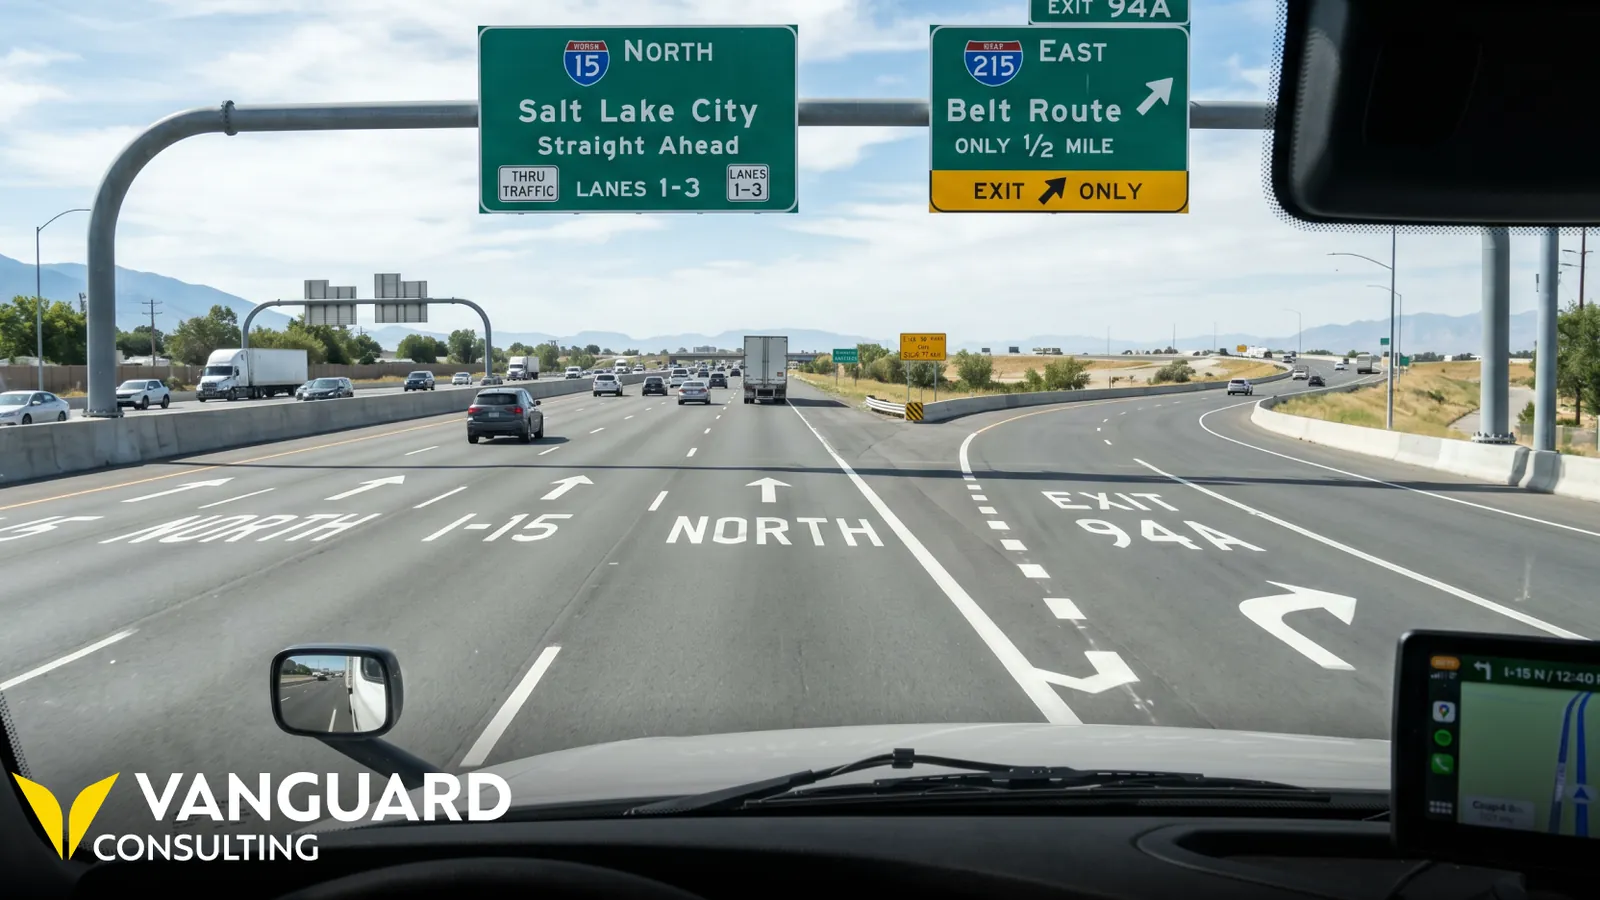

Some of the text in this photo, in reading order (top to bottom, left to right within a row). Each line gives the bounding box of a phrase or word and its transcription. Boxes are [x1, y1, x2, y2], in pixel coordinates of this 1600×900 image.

[1048, 0, 1171, 18] EXIT 94A
[624, 40, 713, 62] NORTH
[1039, 40, 1107, 62] EAST
[575, 55, 600, 77] 15
[973, 55, 1015, 77] 215
[518, 99, 758, 128] Salt Lake City
[947, 98, 1122, 122] Belt Route
[537, 136, 739, 161] Straight Ahead
[955, 138, 1011, 154] ONLY
[1066, 138, 1114, 154] MILE
[511, 170, 546, 183] THRU
[729, 169, 767, 180] LANES
[502, 185, 555, 198] TRAFFIC
[576, 177, 700, 197] LANES 1-3
[734, 182, 763, 197] 1-3
[974, 183, 1143, 200] EXIT ONLY
[1041, 491, 1179, 512] EXIT
[98, 512, 383, 544] NORTH
[421, 513, 574, 542] I-15
[665, 515, 885, 547] NORTH
[1075, 518, 1268, 552] 94A
